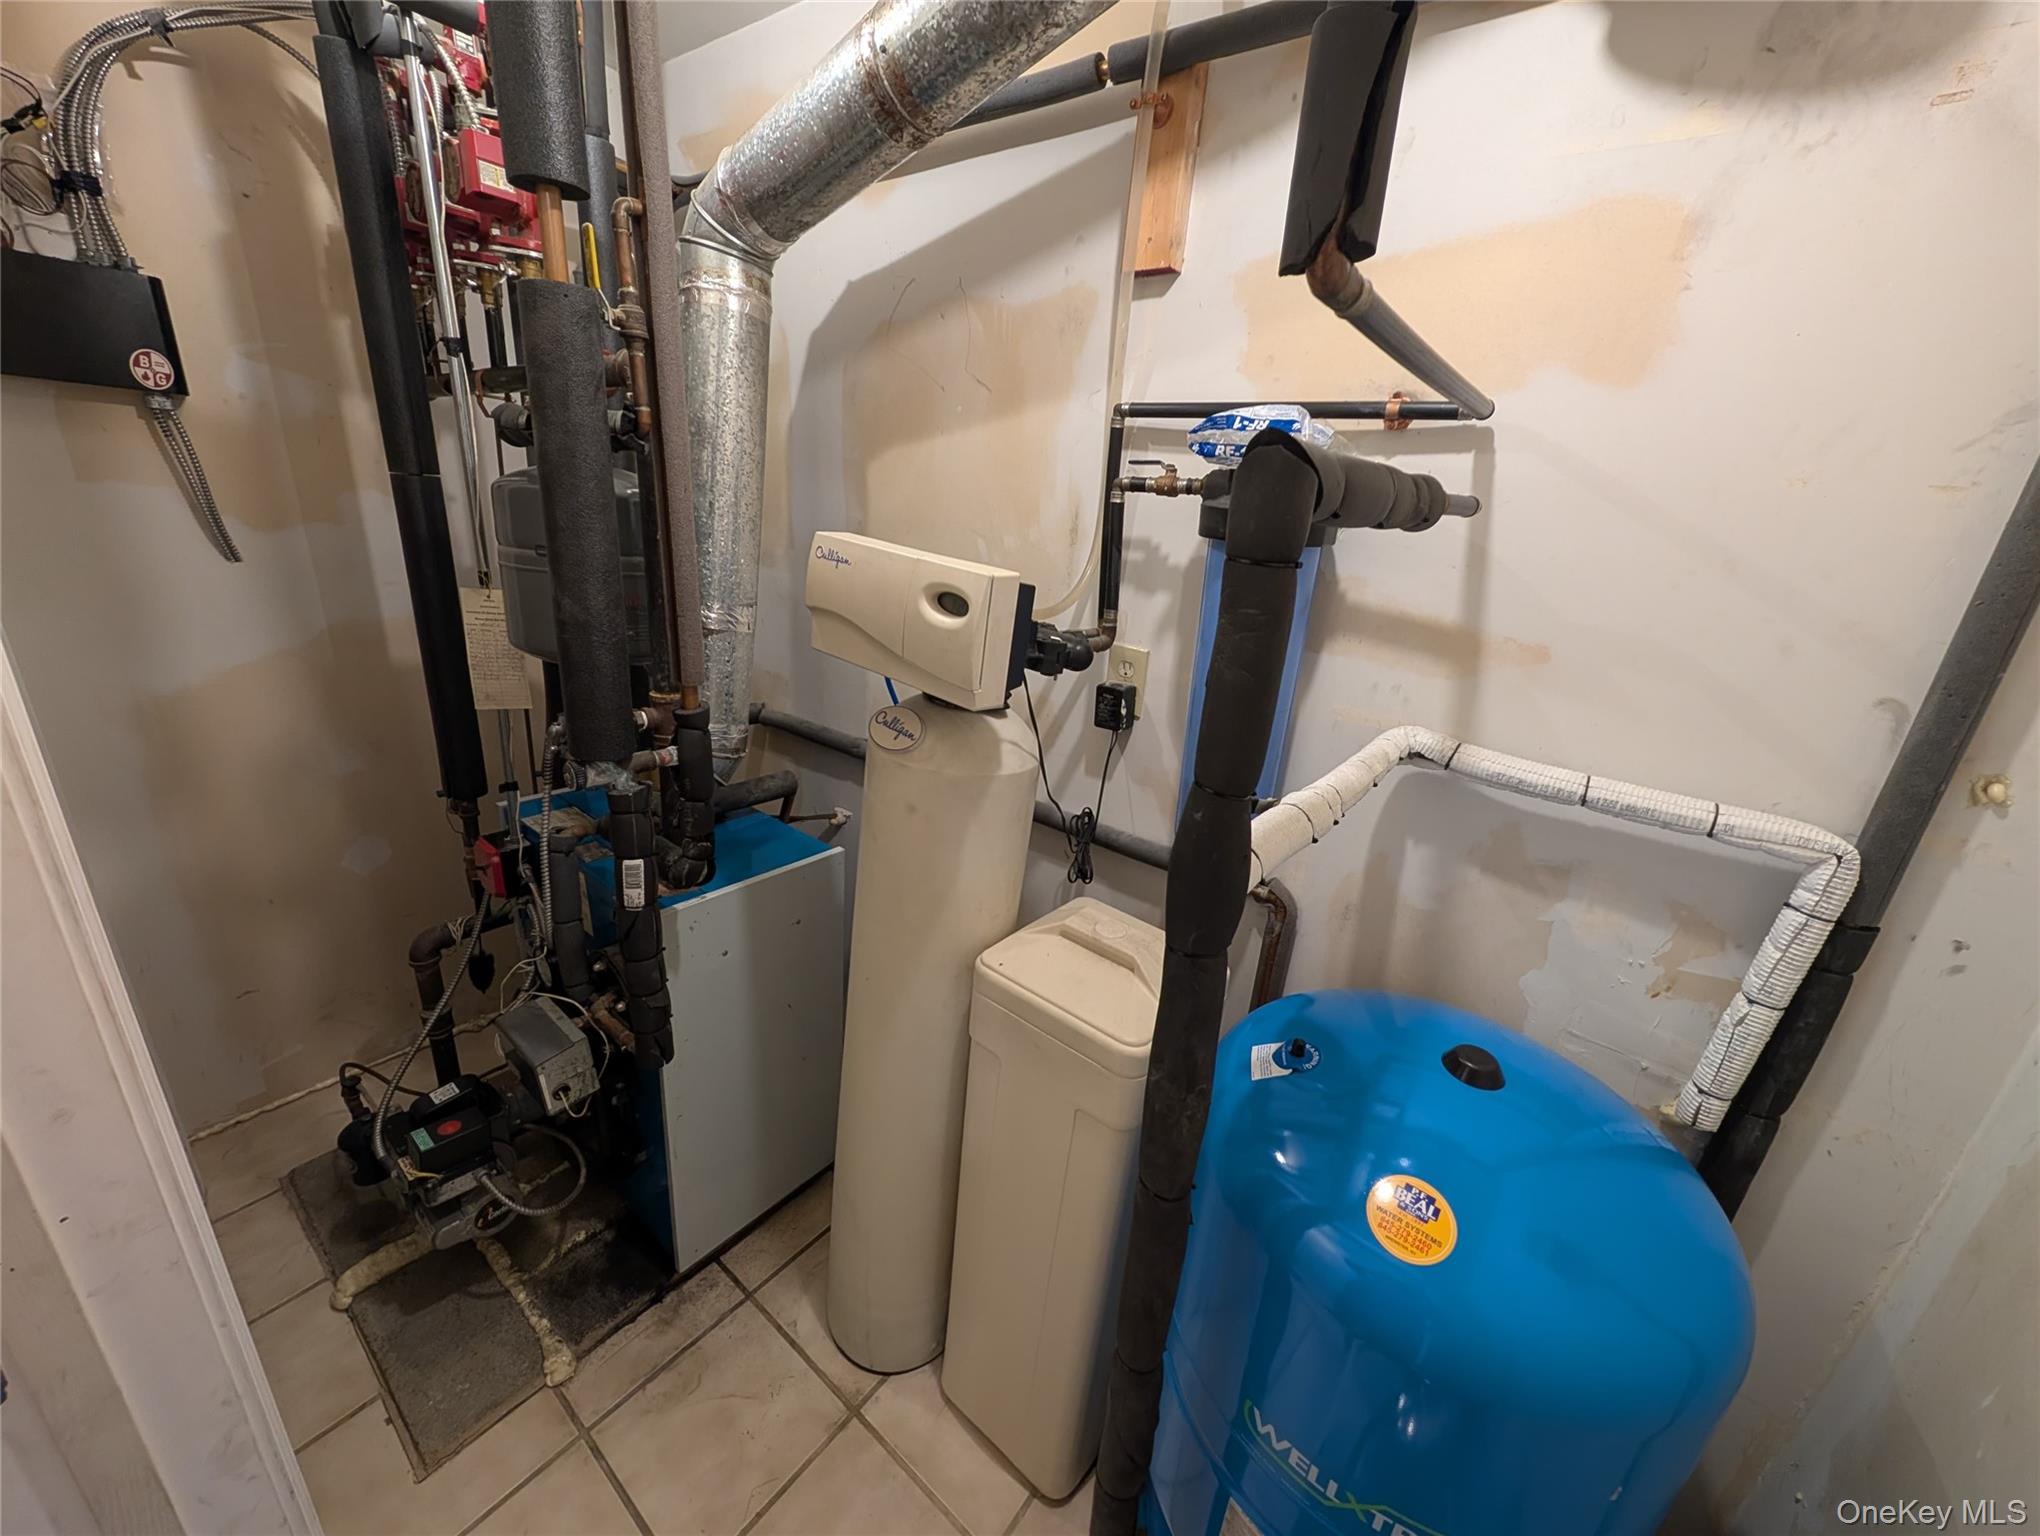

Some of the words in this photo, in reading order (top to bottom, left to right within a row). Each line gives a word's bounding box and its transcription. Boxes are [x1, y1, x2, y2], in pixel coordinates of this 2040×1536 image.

[139, 355, 150, 368] B
[155, 373, 167, 386] G
[1233, 415, 1270, 431] RF-1
[815, 546, 851, 568] Culligan
[875, 711, 915, 740] Culligan
[1394, 1187, 1438, 1220] BEAL
[1376, 1205, 1403, 1225] WATER
[1405, 1222, 1443, 1249] SYSTEMS
